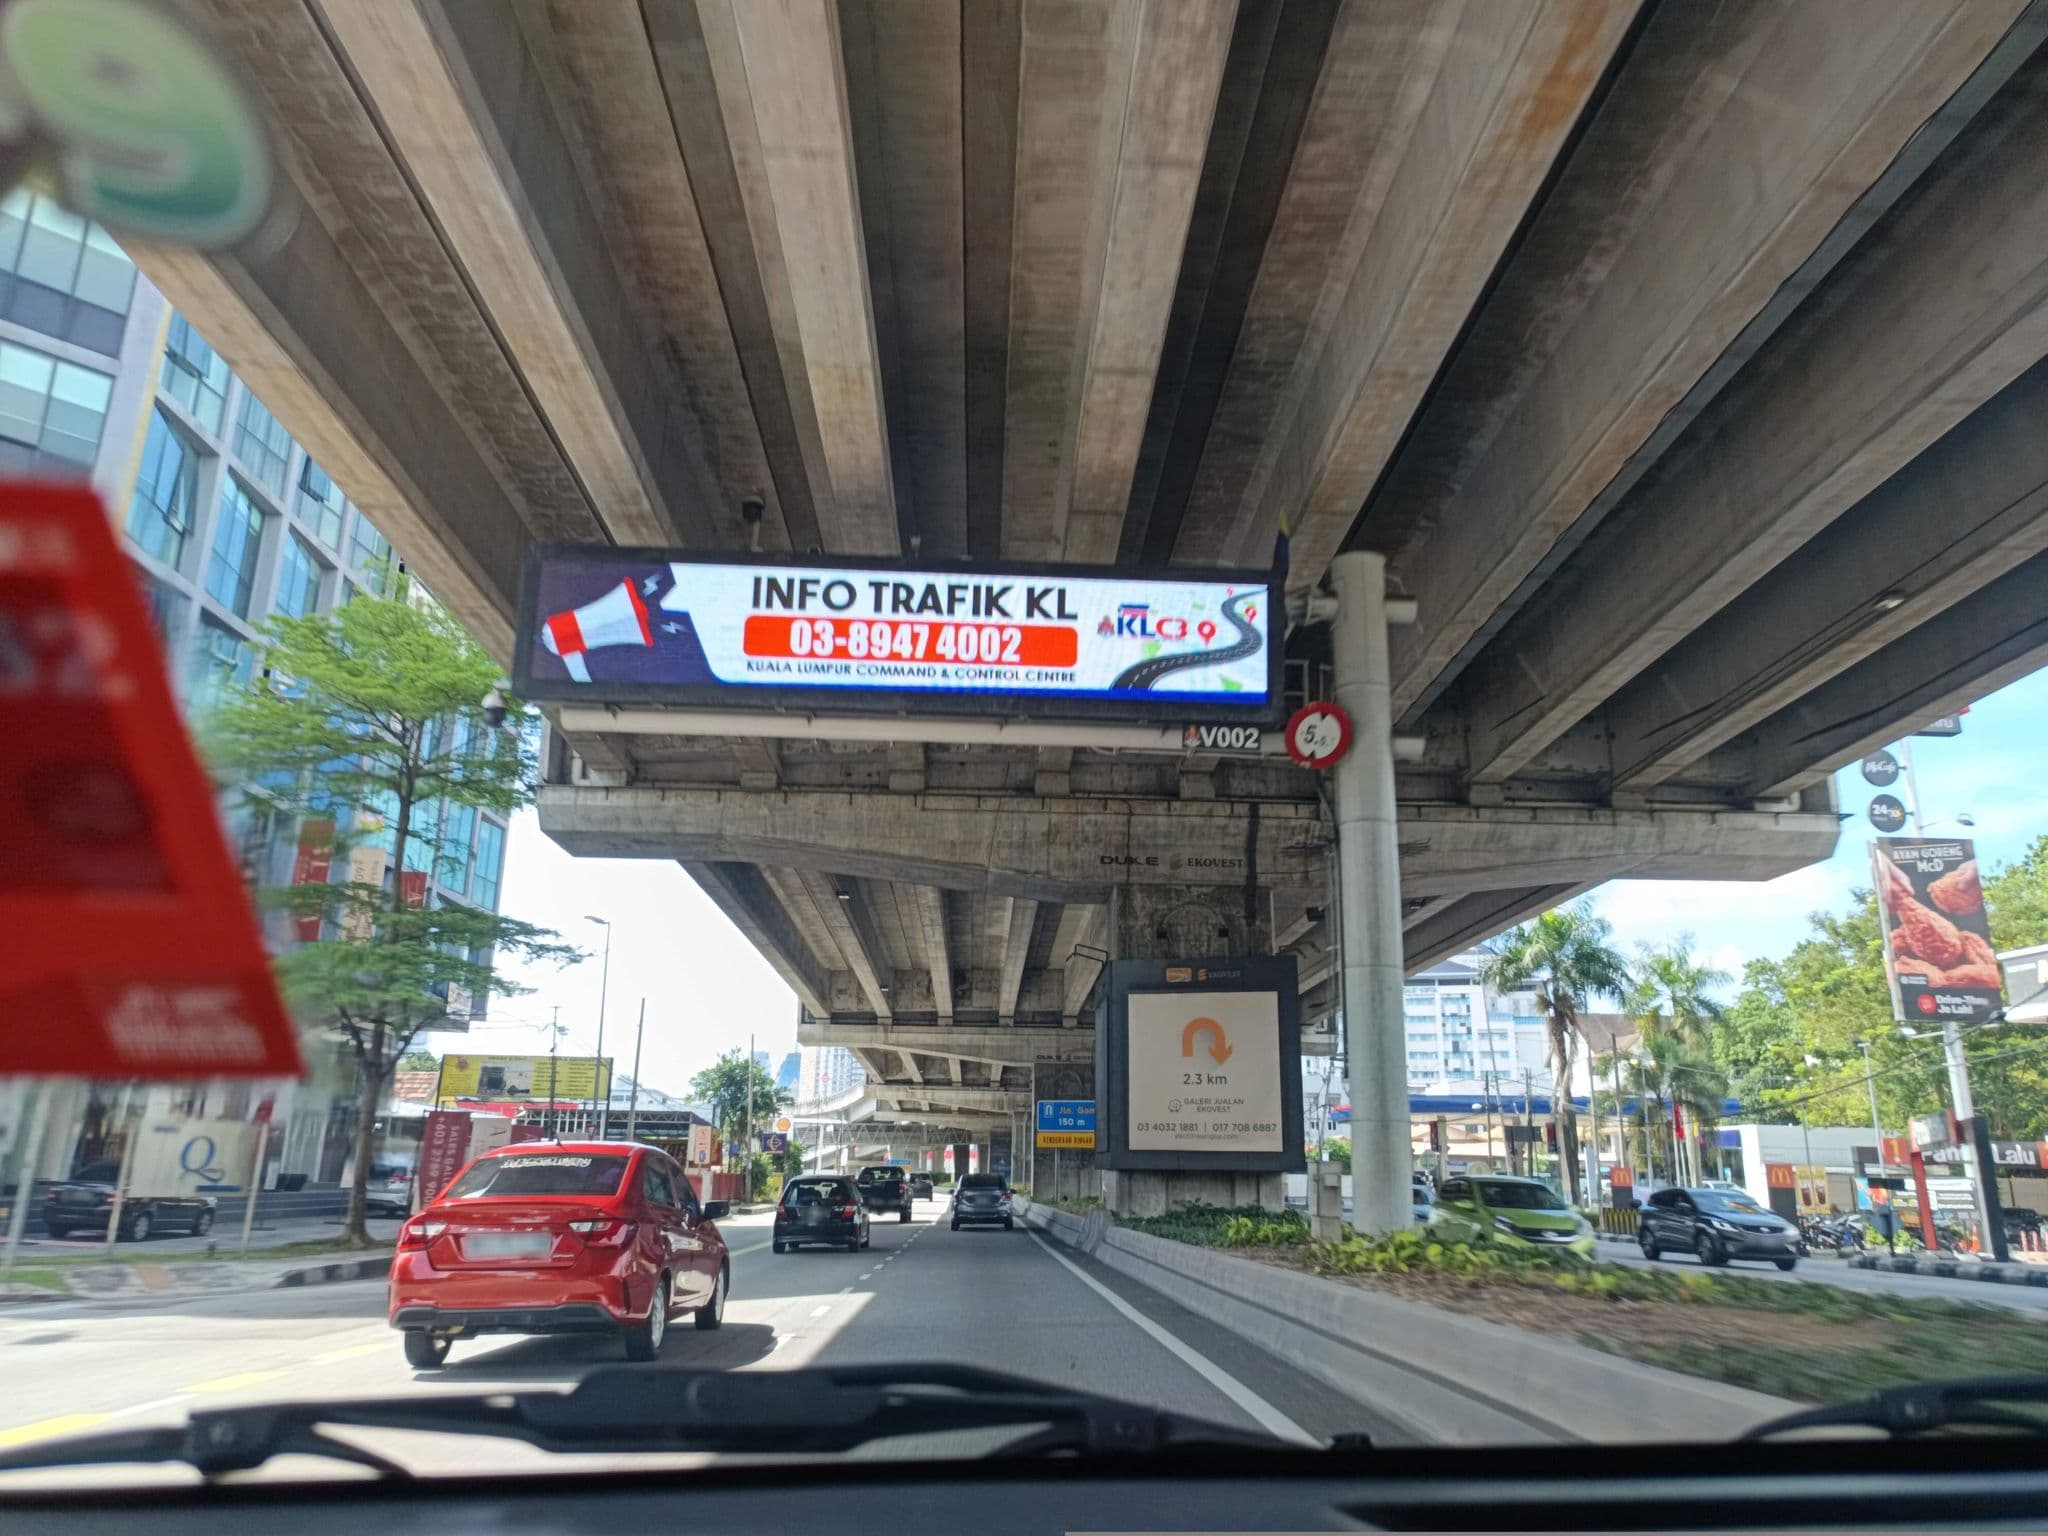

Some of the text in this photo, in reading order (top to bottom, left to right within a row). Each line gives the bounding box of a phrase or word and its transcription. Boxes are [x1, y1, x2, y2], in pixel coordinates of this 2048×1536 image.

[752, 575, 1078, 620] INFO TRAFIK KL
[788, 621, 1022, 664] 03-8947 4002
[747, 661, 792, 673] KUALA
[797, 663, 852, 675] LUMPUR
[856, 664, 937, 678] COMMAND
[956, 668, 1020, 682] CONTROL
[1026, 670, 1077, 684] CENTRE
[1200, 726, 1259, 749] V002
[1100, 855, 1244, 868] DUKE EKOVEST
[1916, 858, 1944, 873] McD
[1183, 1073, 1227, 1085] 2.3 km
[1058, 1118, 1074, 1126] 150
[1137, 1123, 1150, 1132] 03
[1152, 1123, 1176, 1132] 4032
[1179, 1123, 1198, 1132] 1881
[1212, 1123, 1229, 1132] 017
[1232, 1123, 1250, 1132] 708
[1990, 1143, 2036, 1166] Lalu
